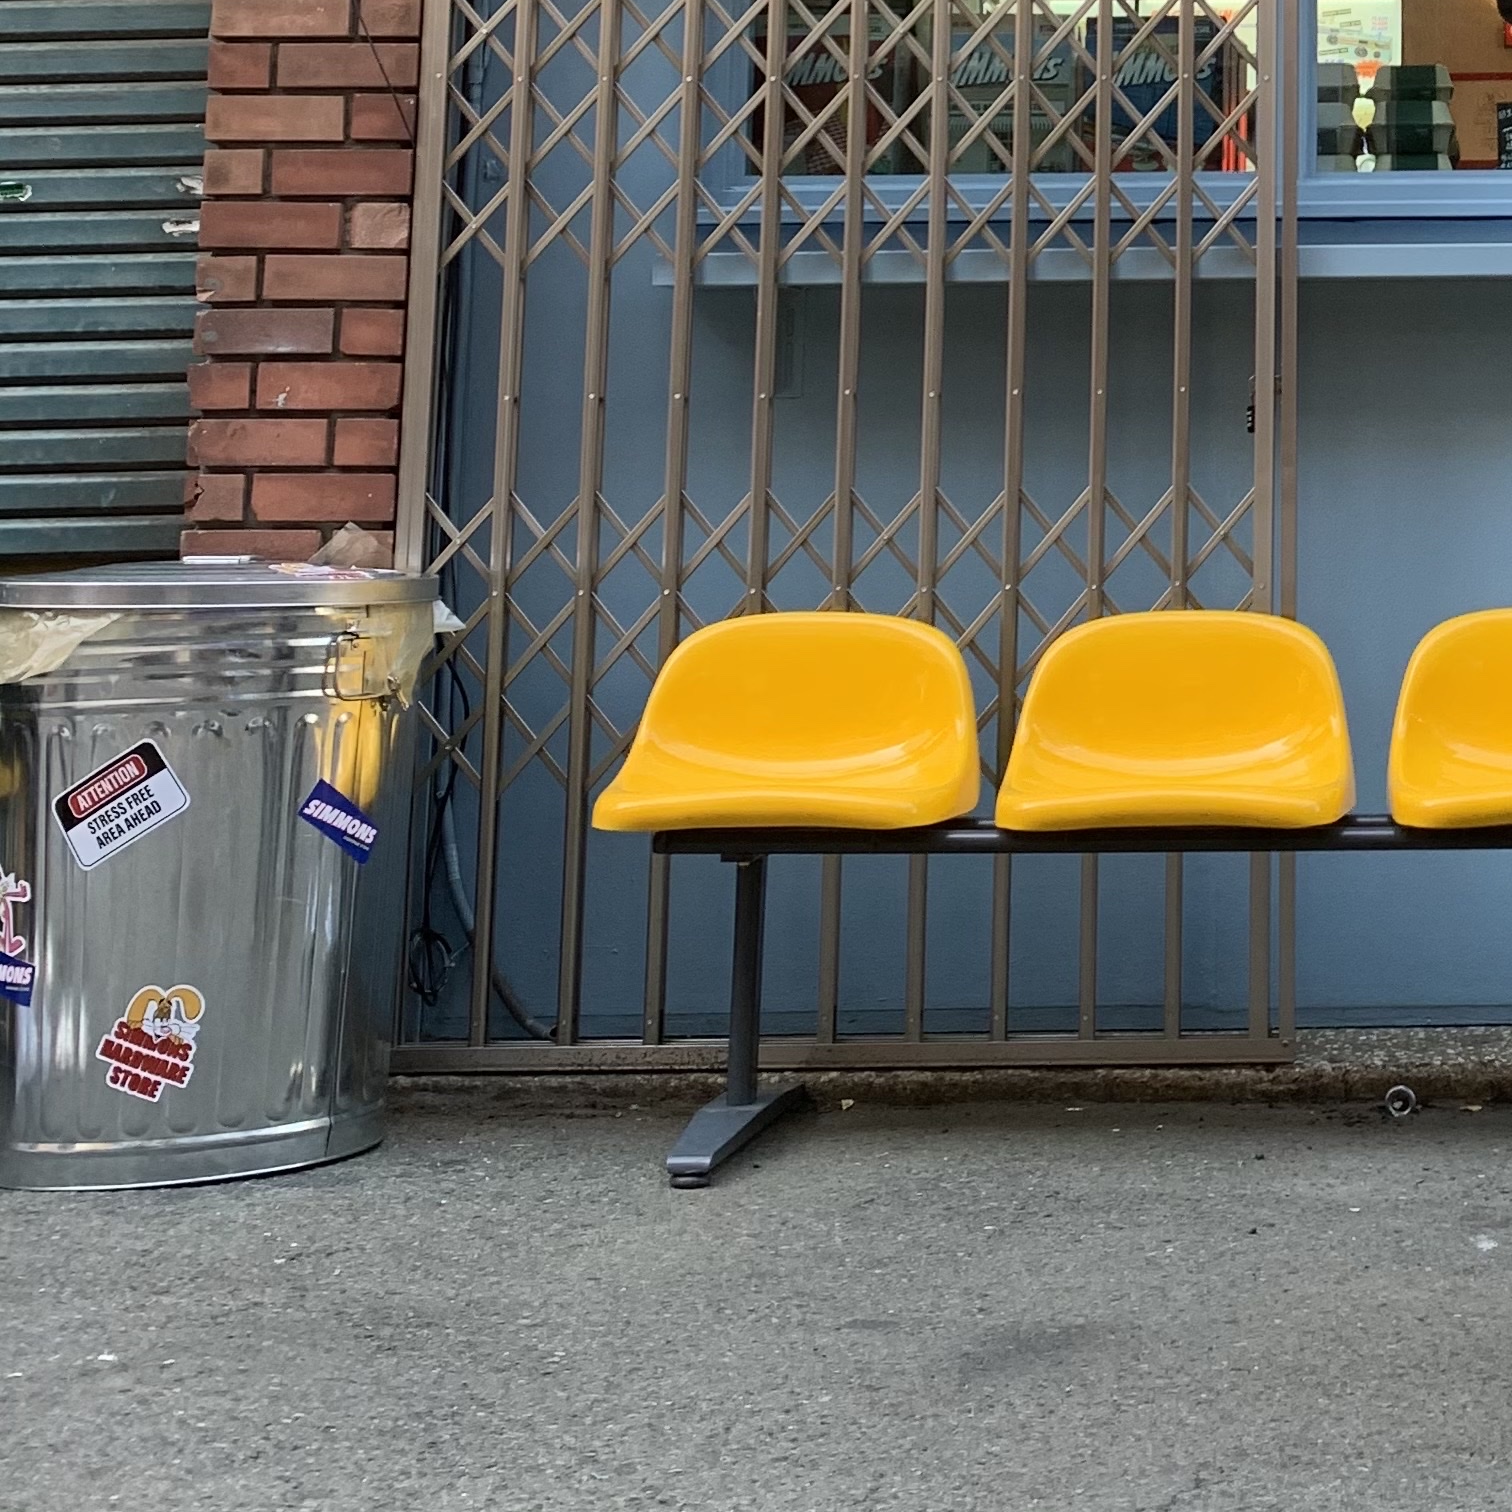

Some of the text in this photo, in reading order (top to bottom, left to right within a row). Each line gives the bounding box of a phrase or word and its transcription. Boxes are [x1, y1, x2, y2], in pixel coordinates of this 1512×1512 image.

[75, 760, 141, 812] ATTENTION
[87, 784, 155, 835] STRESS FREE
[96, 800, 162, 849] AREA AHEAD
[302, 799, 378, 844] SIMMONS
[99, 1038, 190, 1085] HARDWARE
[110, 1066, 162, 1099] STORE
